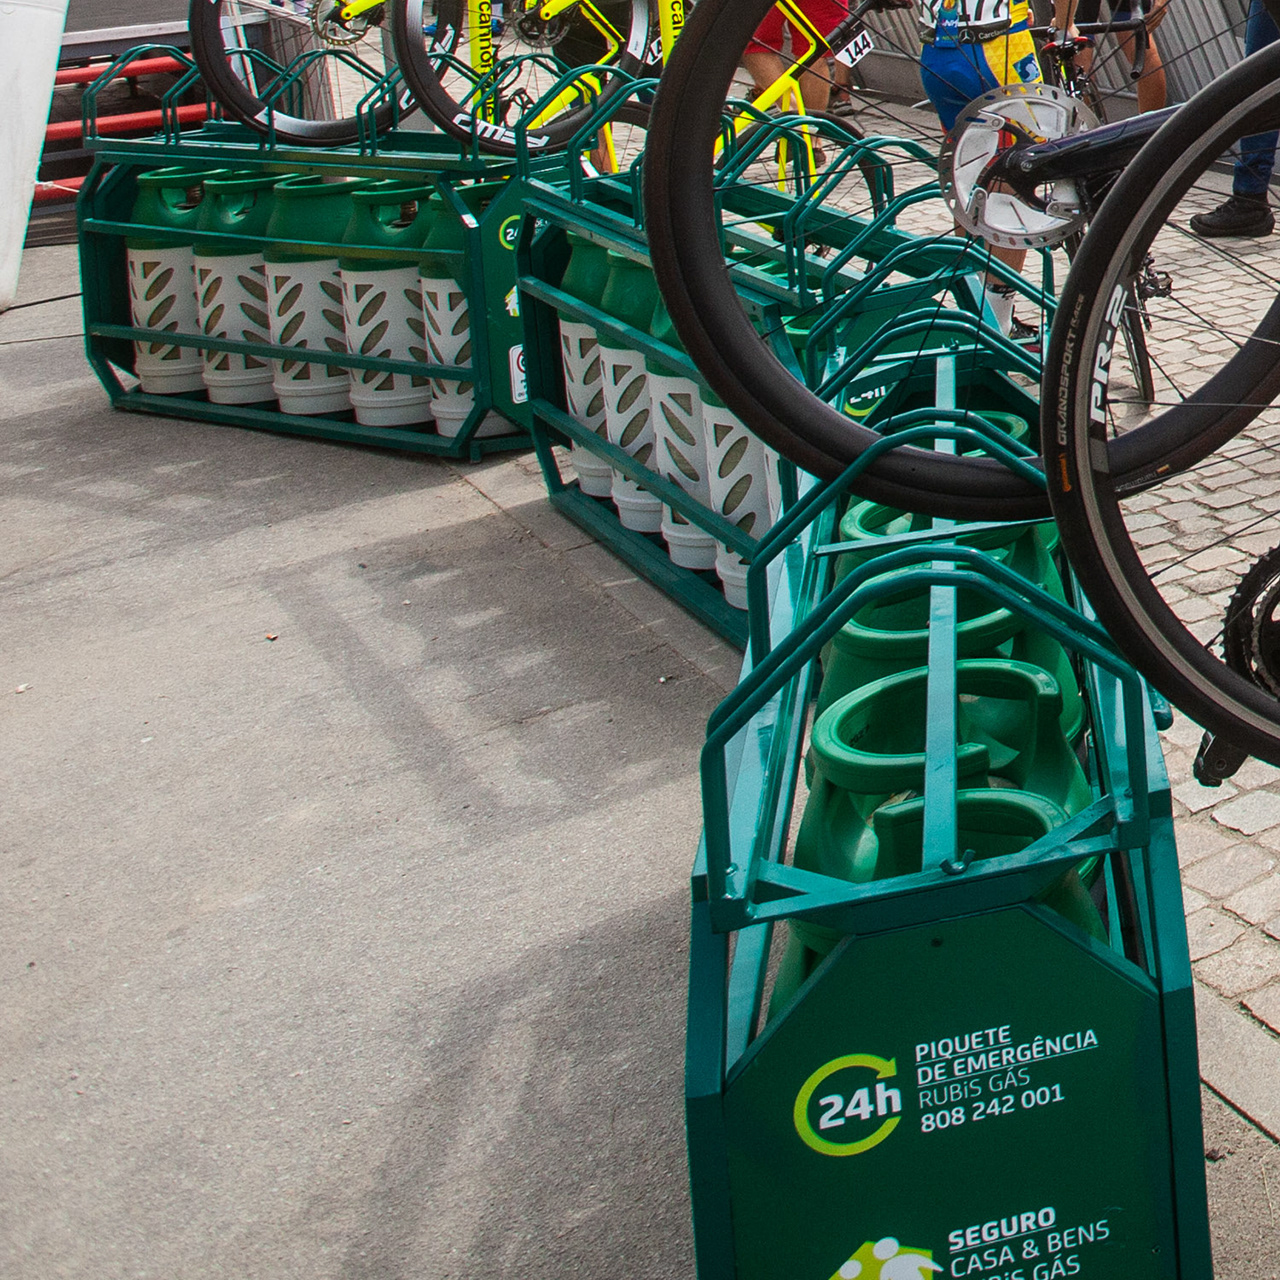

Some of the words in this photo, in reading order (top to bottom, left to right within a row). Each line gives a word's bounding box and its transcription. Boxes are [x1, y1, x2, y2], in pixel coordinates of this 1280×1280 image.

[844, 32, 871, 64] 144
[1090, 283, 1129, 424] PR-2
[915, 1025, 1012, 1063] PIQUETE
[916, 1062, 948, 1086] DE
[953, 1028, 1099, 1079] EMERGÊNCIA
[988, 1065, 1032, 1094] GÁS
[818, 1082, 902, 1130] 24h
[920, 1108, 966, 1134] 808
[972, 1096, 1016, 1123] 242
[1020, 1083, 1065, 1109] 001
[947, 1206, 1057, 1253] SEGURO
[950, 1245, 1015, 1280] CASA
[1021, 1238, 1040, 1258] &
[1047, 1219, 1111, 1252] BENS
[1033, 1254, 1081, 1280] GÁS
